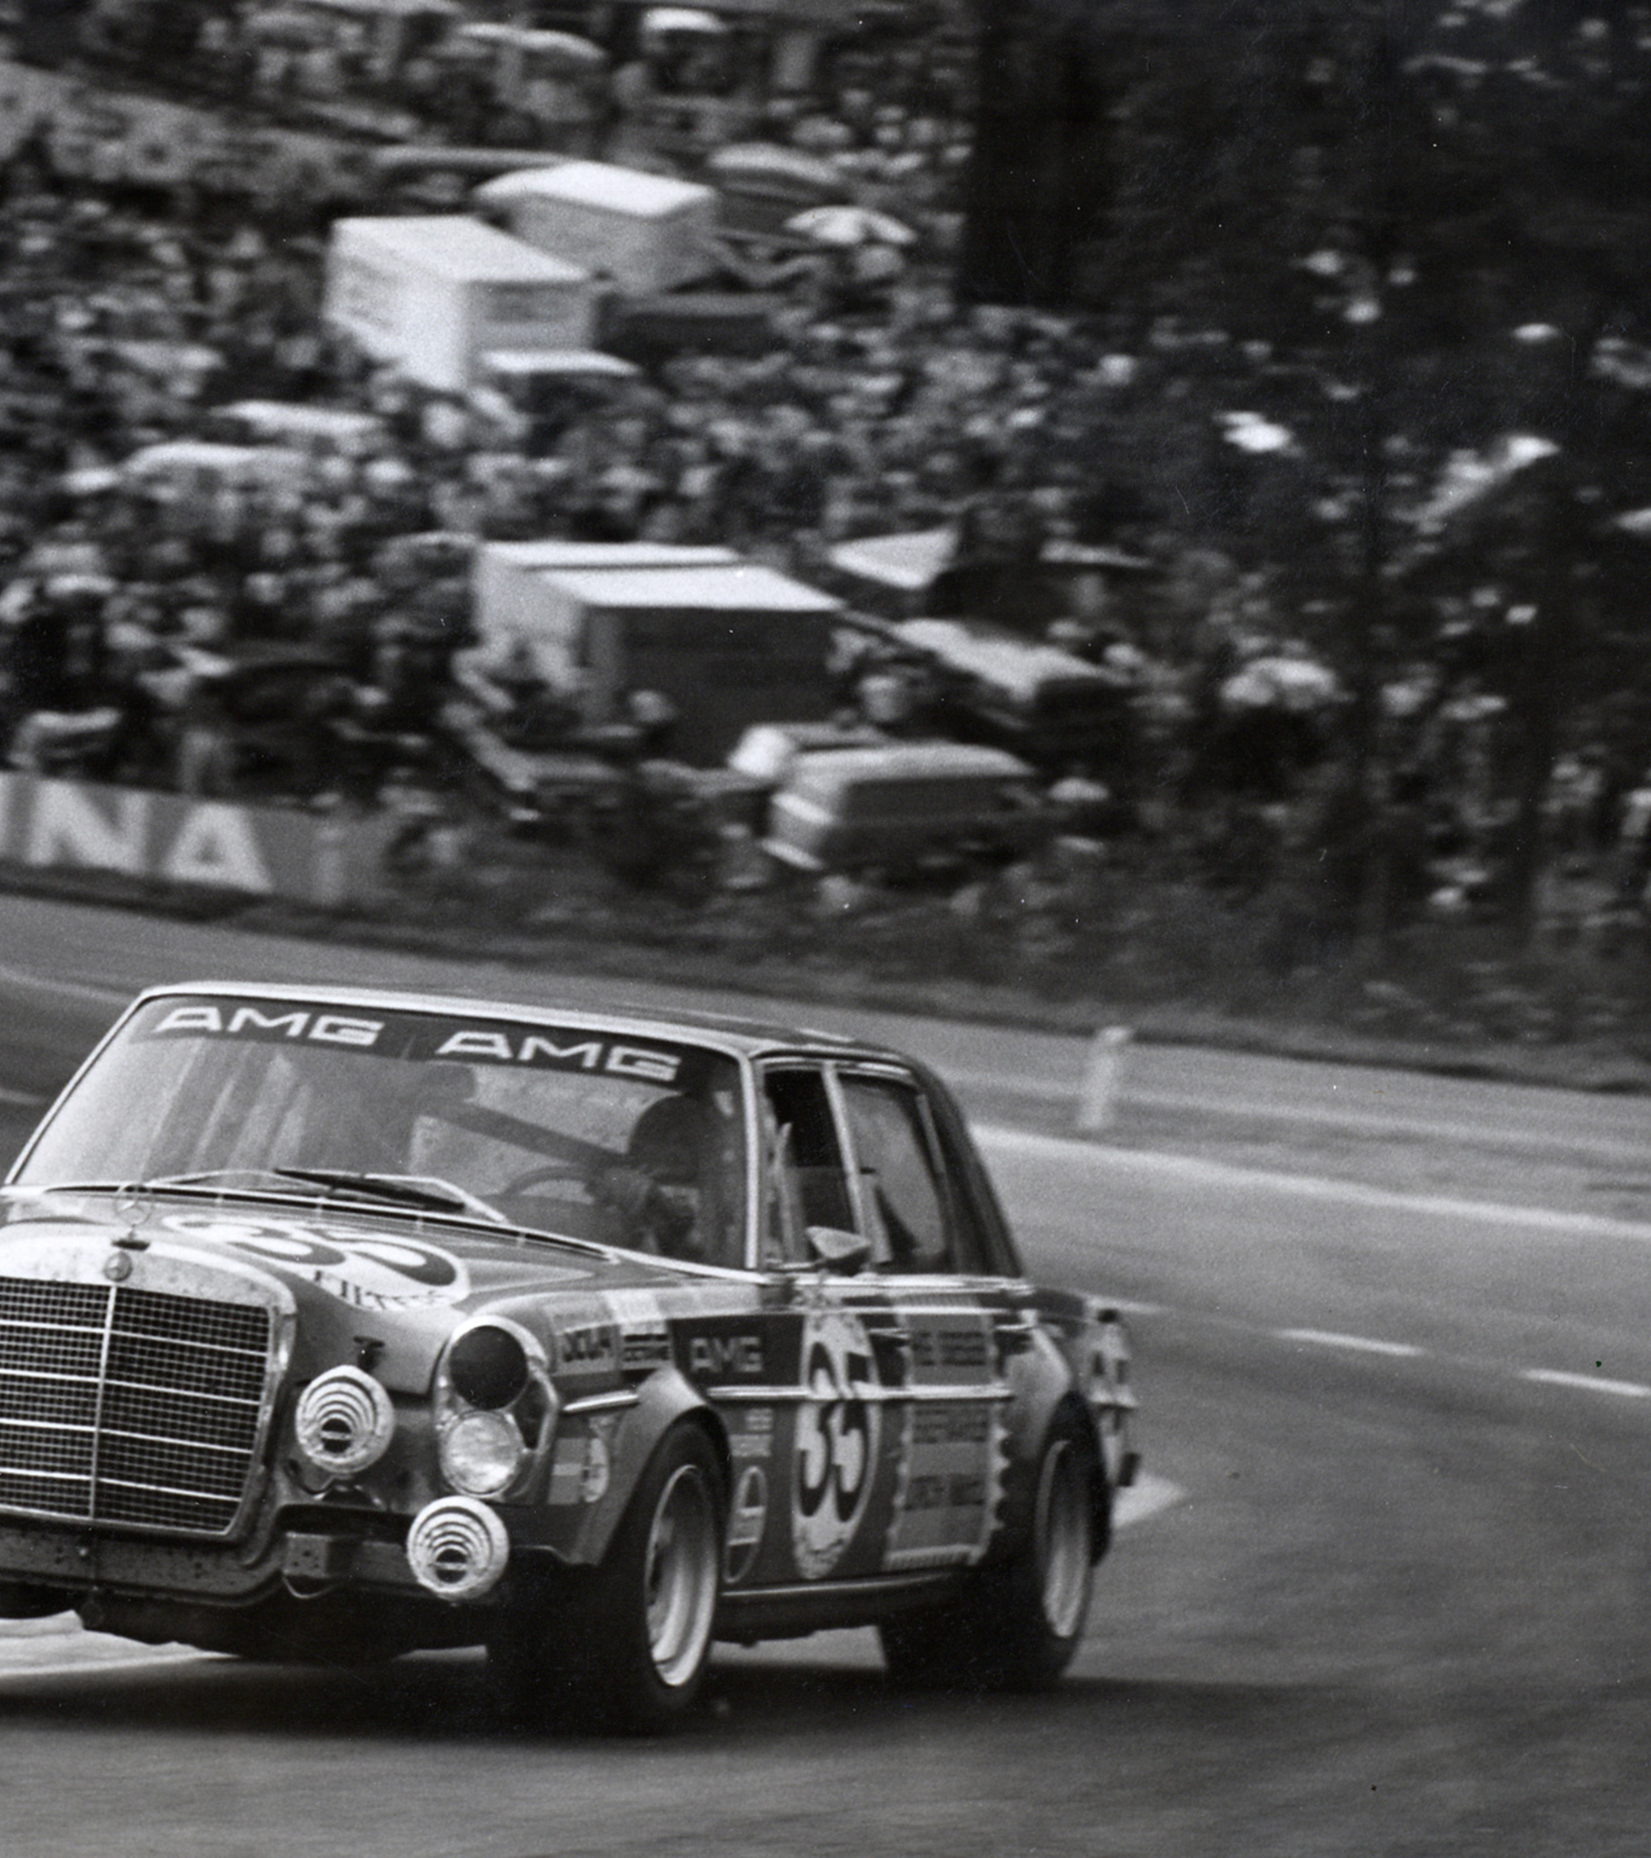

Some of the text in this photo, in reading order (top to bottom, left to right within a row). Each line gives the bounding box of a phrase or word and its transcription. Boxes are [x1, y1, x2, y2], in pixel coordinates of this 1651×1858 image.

[152, 1005, 682, 1083] AMG AMG
[177, 1218, 459, 1288] 35
[689, 1336, 763, 1373] AMG
[800, 1340, 871, 1523] 35
